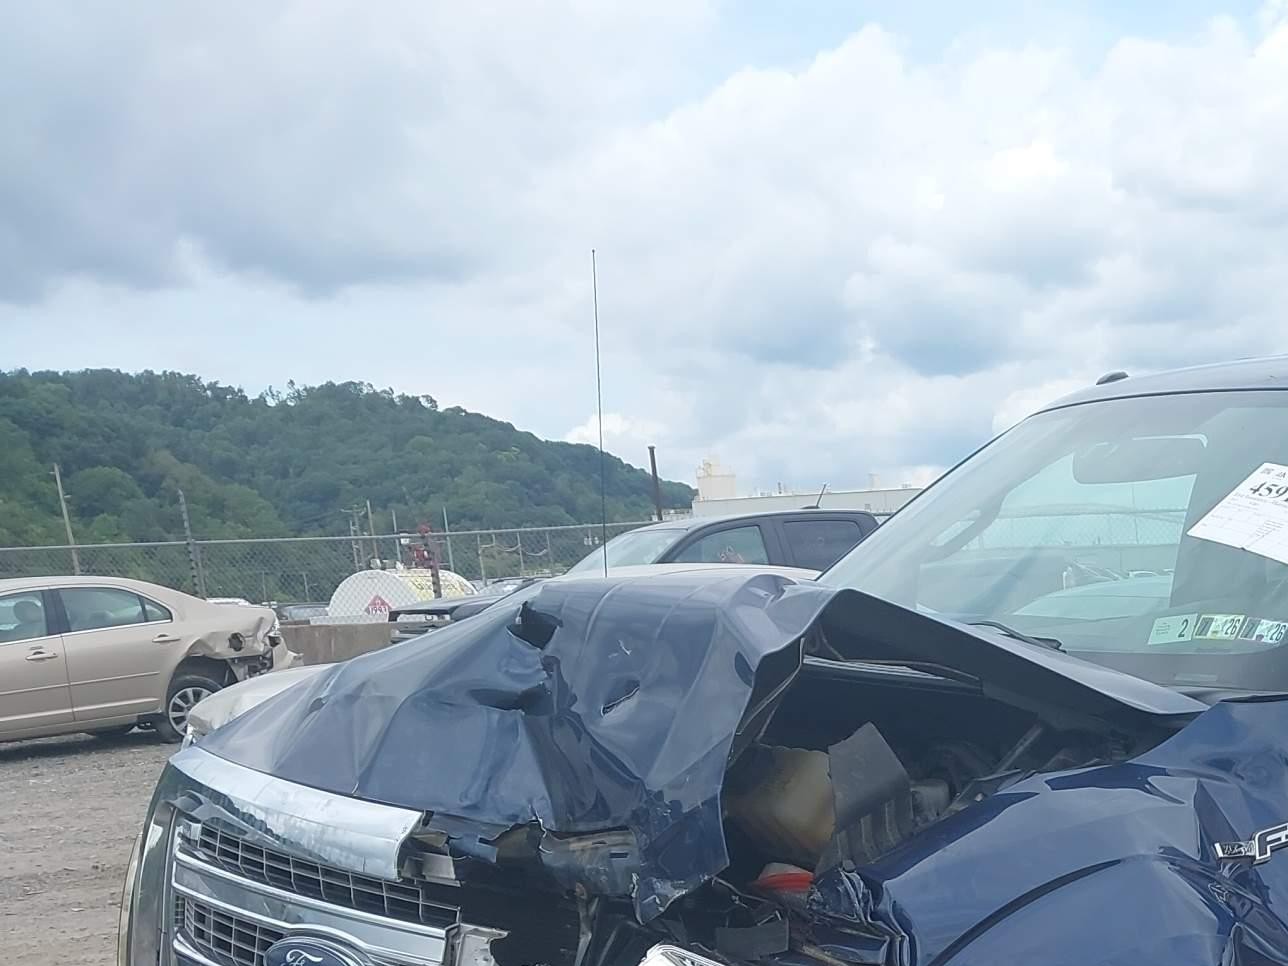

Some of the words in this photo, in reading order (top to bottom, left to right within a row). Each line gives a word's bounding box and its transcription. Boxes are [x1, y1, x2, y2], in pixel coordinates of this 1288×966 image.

[1177, 618, 1189, 638] 2
[1224, 618, 1241, 636] 26
[1269, 622, 1287, 641] 26
